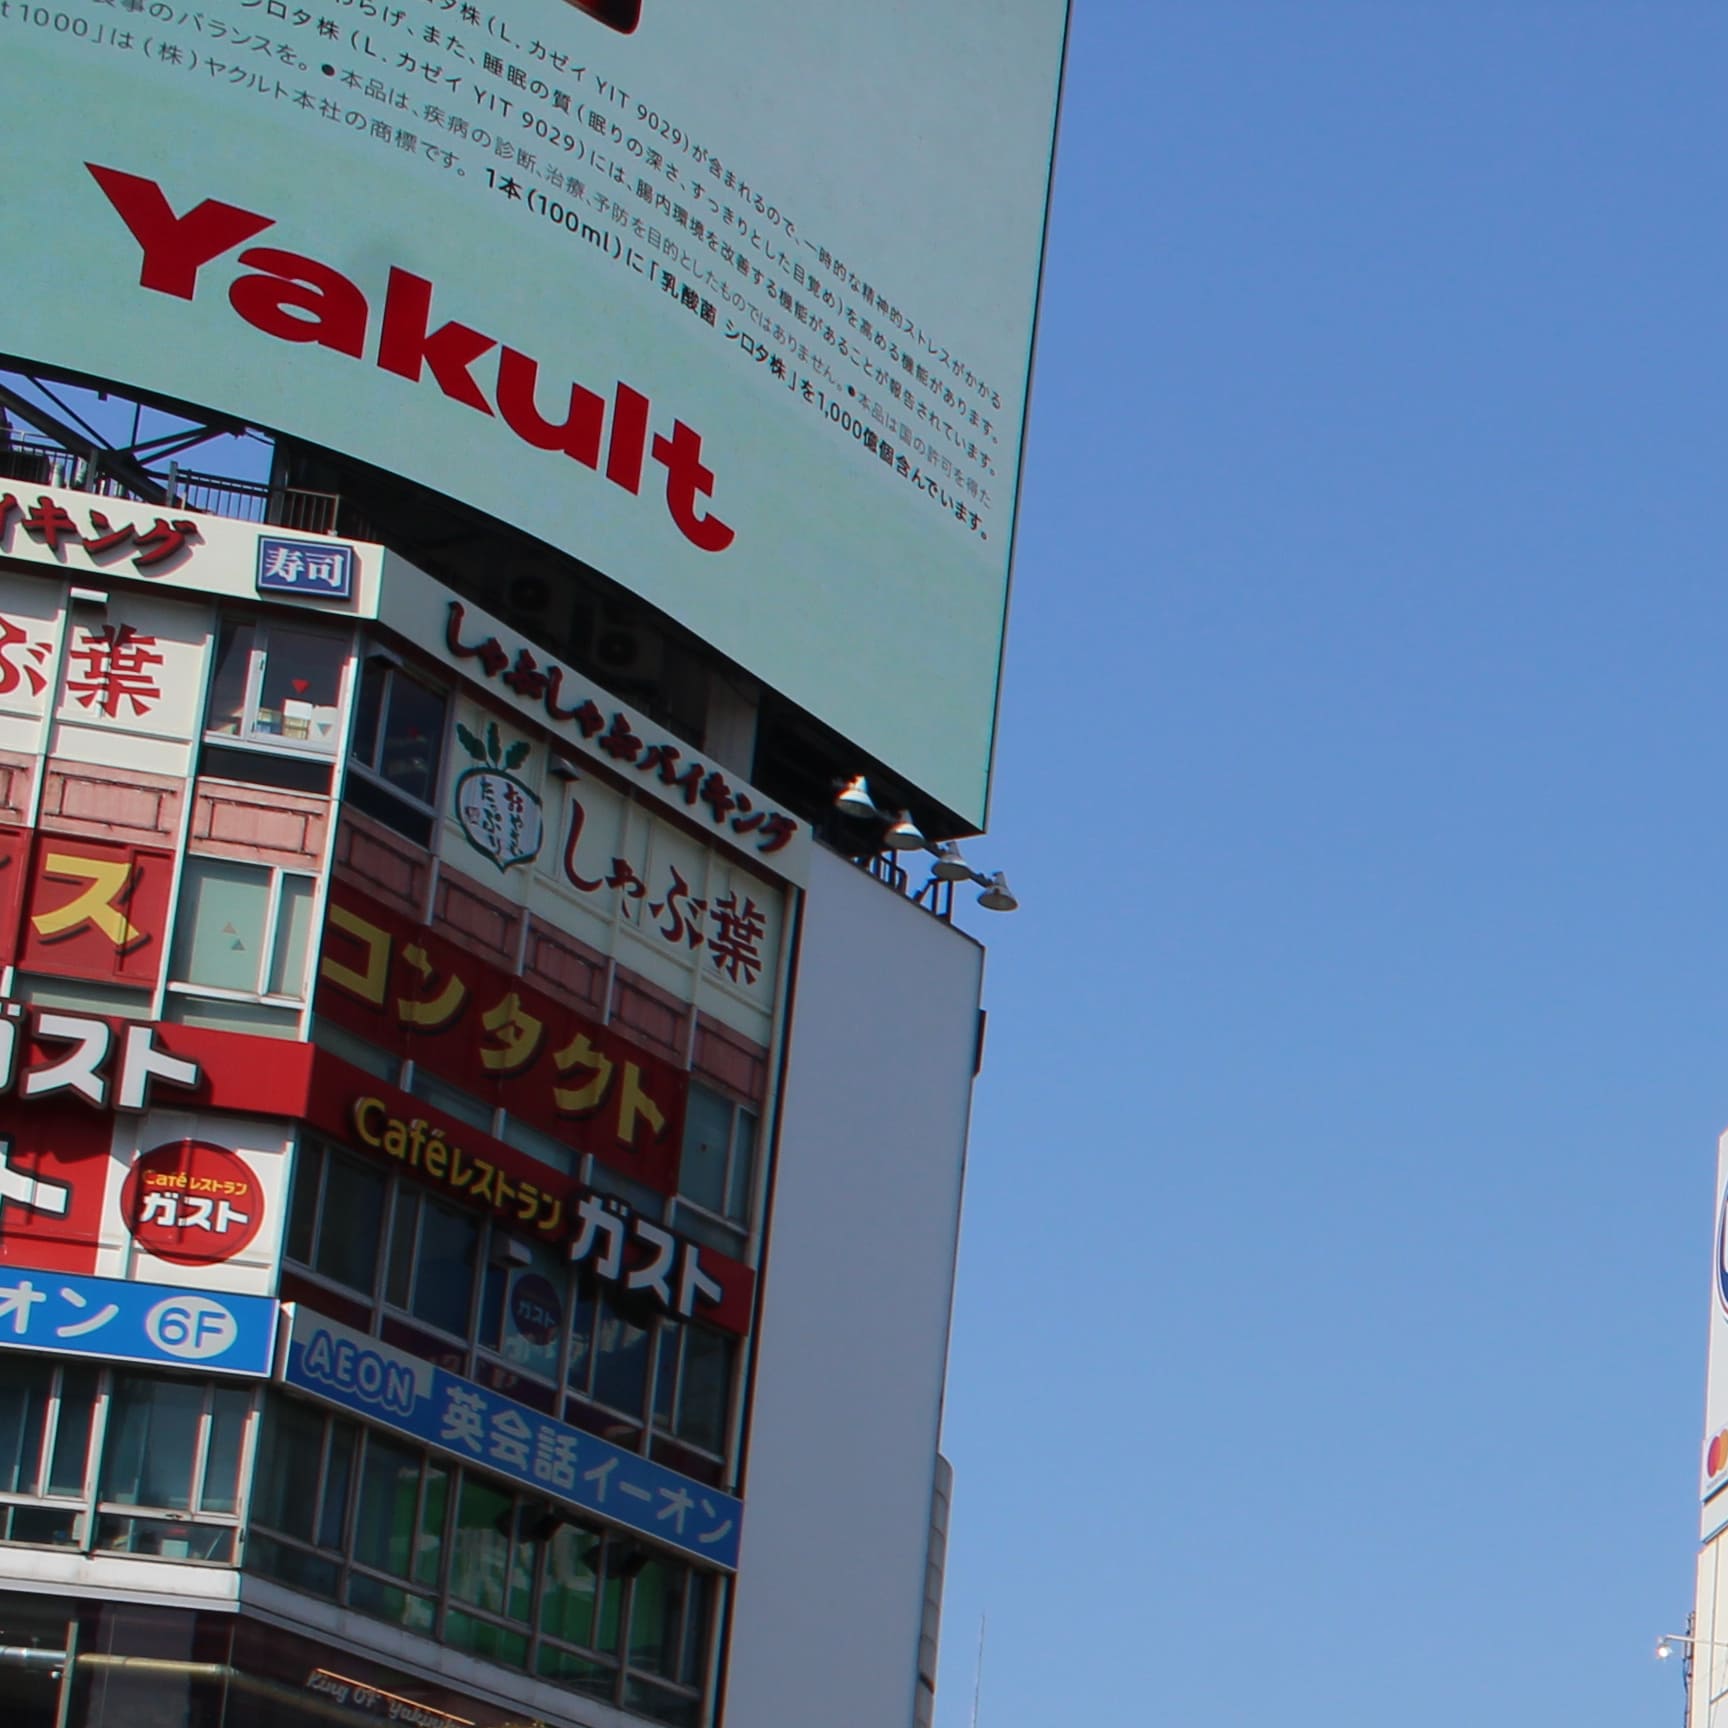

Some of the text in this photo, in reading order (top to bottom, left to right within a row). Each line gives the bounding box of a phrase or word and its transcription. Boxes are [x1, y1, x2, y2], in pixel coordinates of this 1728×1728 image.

[83, 161, 736, 552] Yakult
[265, 546, 345, 588] 寿司
[564, 798, 767, 985] しゃぶ葉
[320, 902, 666, 1143] コンタクト
[142, 1192, 249, 1234] ガスト
[571, 1193, 722, 1318] ガスト
[155, 1306, 227, 1348] 6F
[303, 1330, 733, 1543] AEON 英会話イーオン
